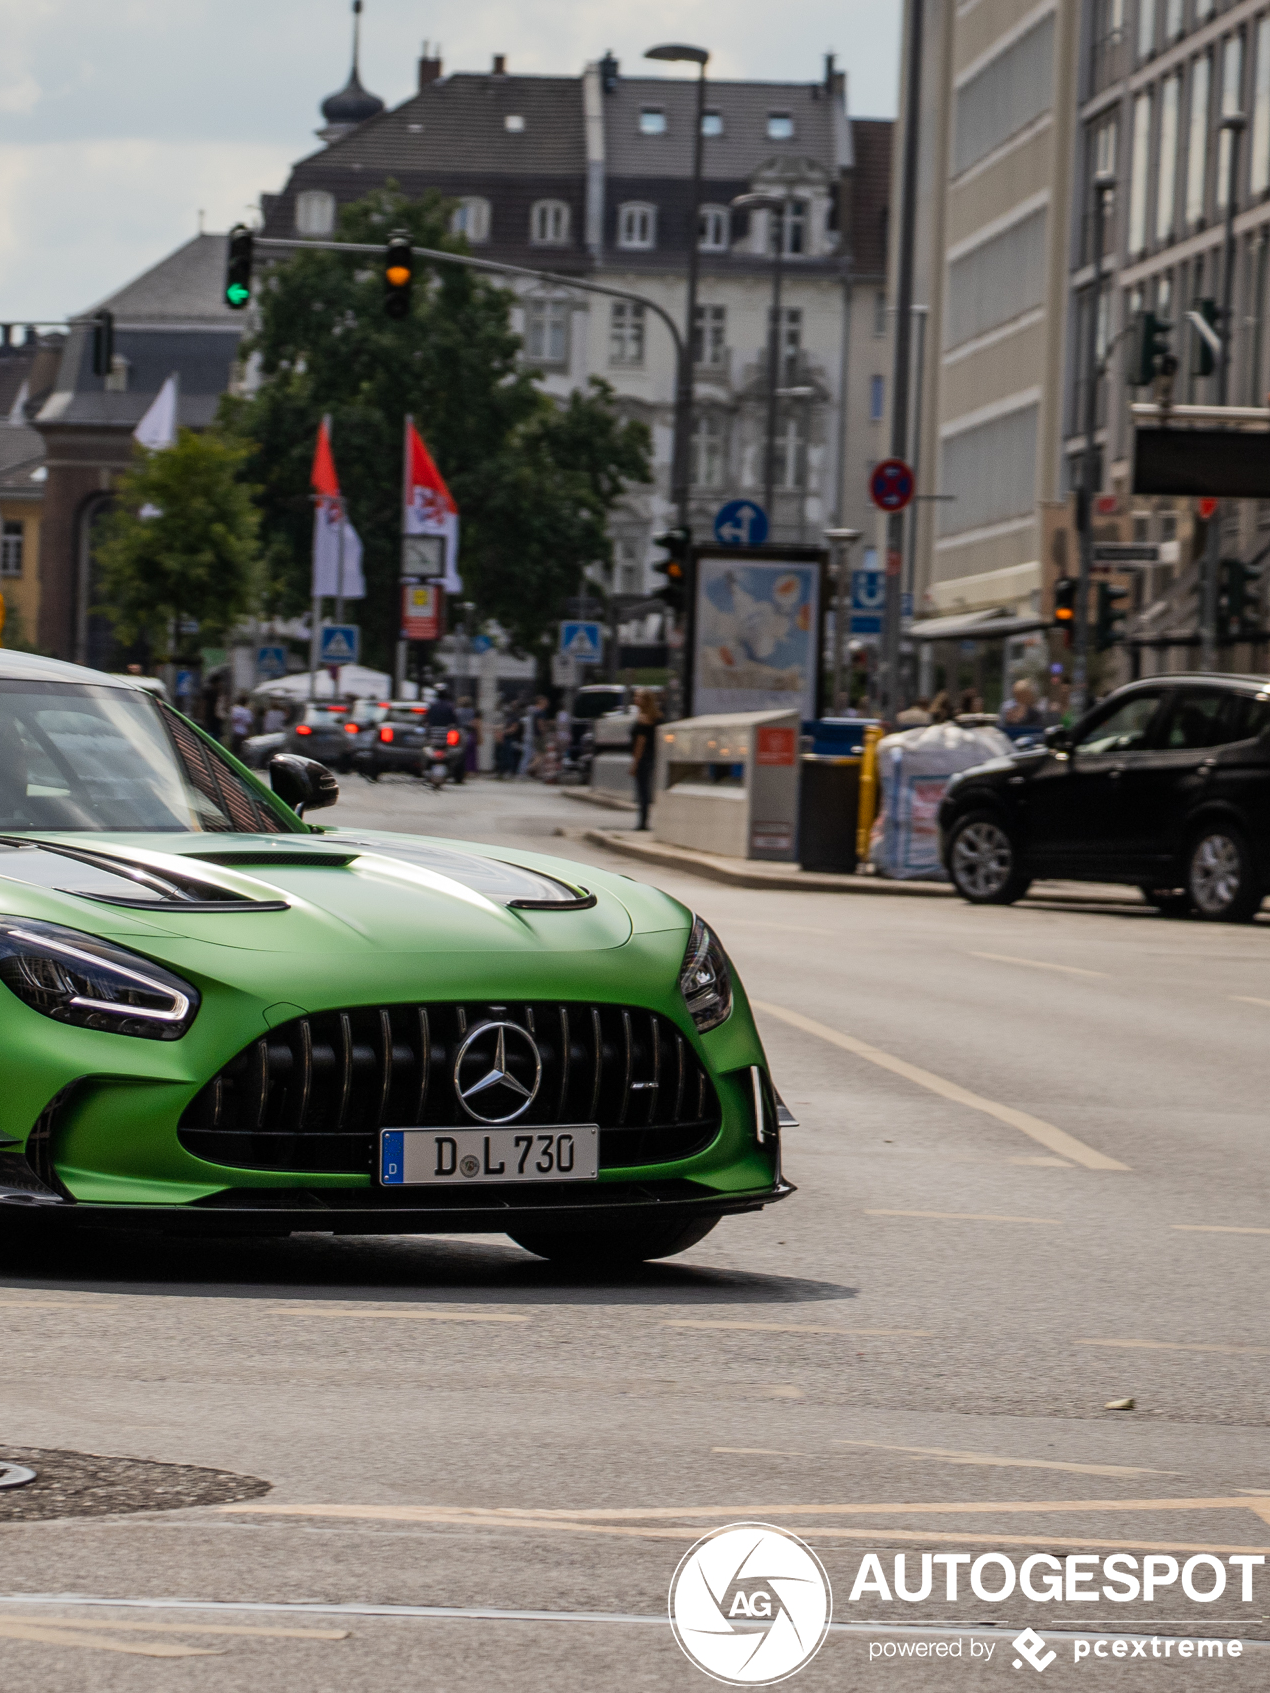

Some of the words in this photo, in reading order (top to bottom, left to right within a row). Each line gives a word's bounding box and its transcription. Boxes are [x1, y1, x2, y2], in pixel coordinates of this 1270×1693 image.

[434, 1136, 457, 1176] D
[483, 1135, 505, 1175] L
[514, 1133, 574, 1174] 730
